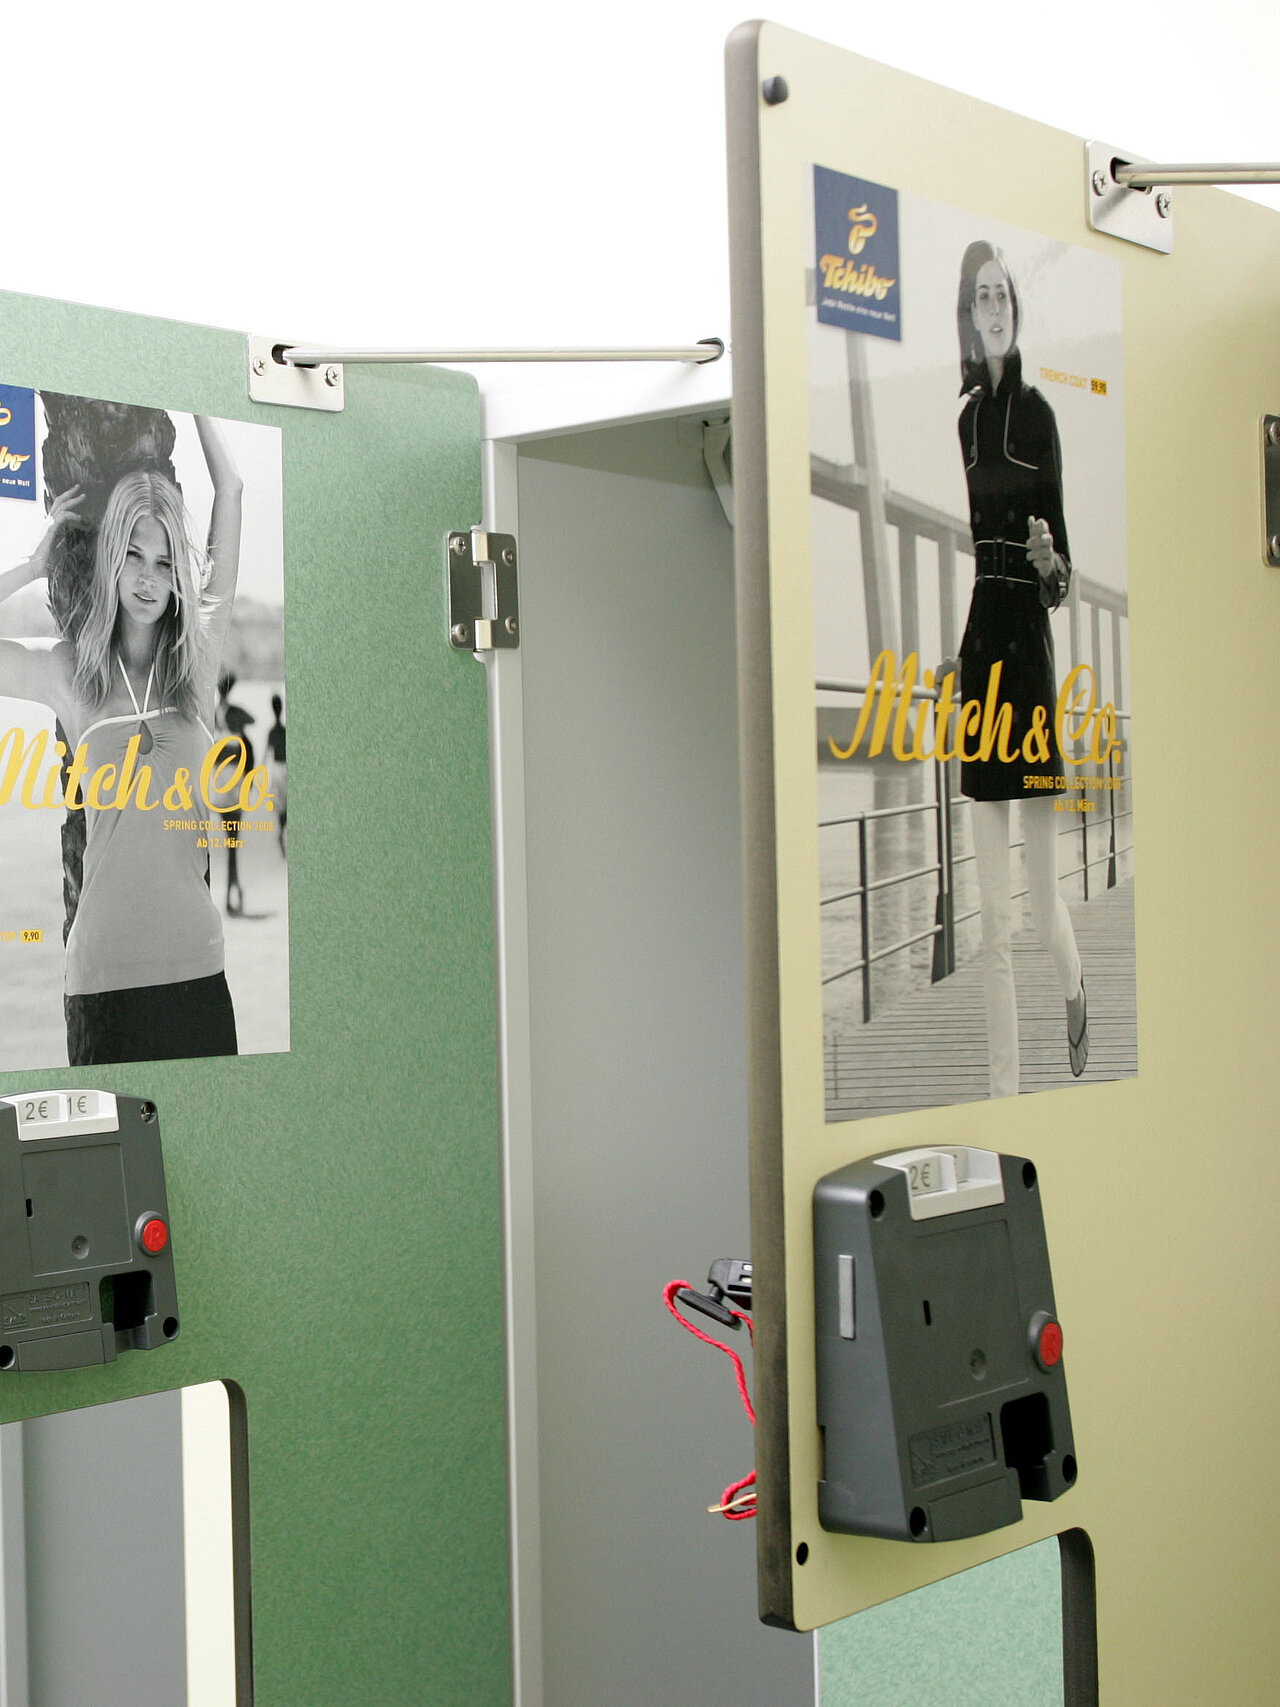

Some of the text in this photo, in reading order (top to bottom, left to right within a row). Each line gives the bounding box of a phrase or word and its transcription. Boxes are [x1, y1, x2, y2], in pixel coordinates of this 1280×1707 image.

[819, 253, 896, 301] Tchibo
[828, 650, 1122, 766] Mitch & Co.
[162, 767, 193, 811] &
[199, 735, 275, 814] Co.
[1023, 775, 1054, 789] SPRING
[1055, 776, 1103, 790] COLLECTION
[163, 820, 197, 831] SPRING
[199, 820, 253, 831] COLLECTION
[196, 837, 245, 848] Ab 12. März
[23, 930, 41, 942] 9,90
